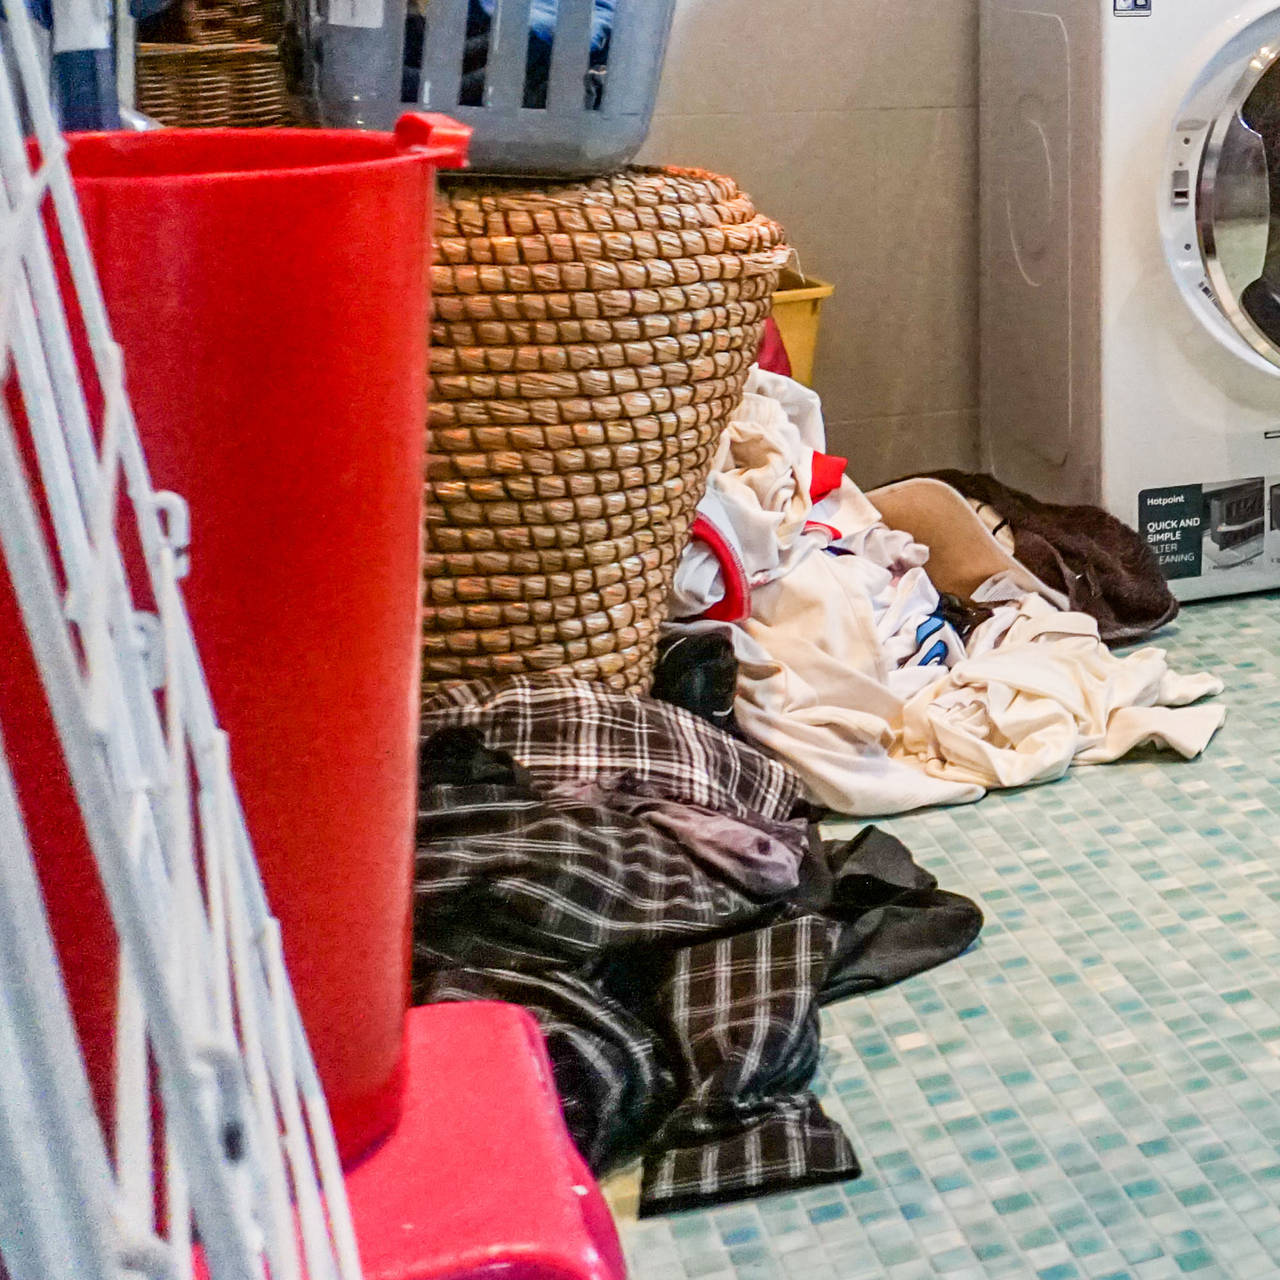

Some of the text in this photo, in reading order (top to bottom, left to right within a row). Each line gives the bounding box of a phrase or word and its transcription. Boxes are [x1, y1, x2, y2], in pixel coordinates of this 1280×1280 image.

[1146, 494, 1184, 506] Hotpoint
[1147, 517, 1200, 533] QUICK AND
[1147, 531, 1182, 543] SIMPLE
[1159, 552, 1195, 565] EANING
